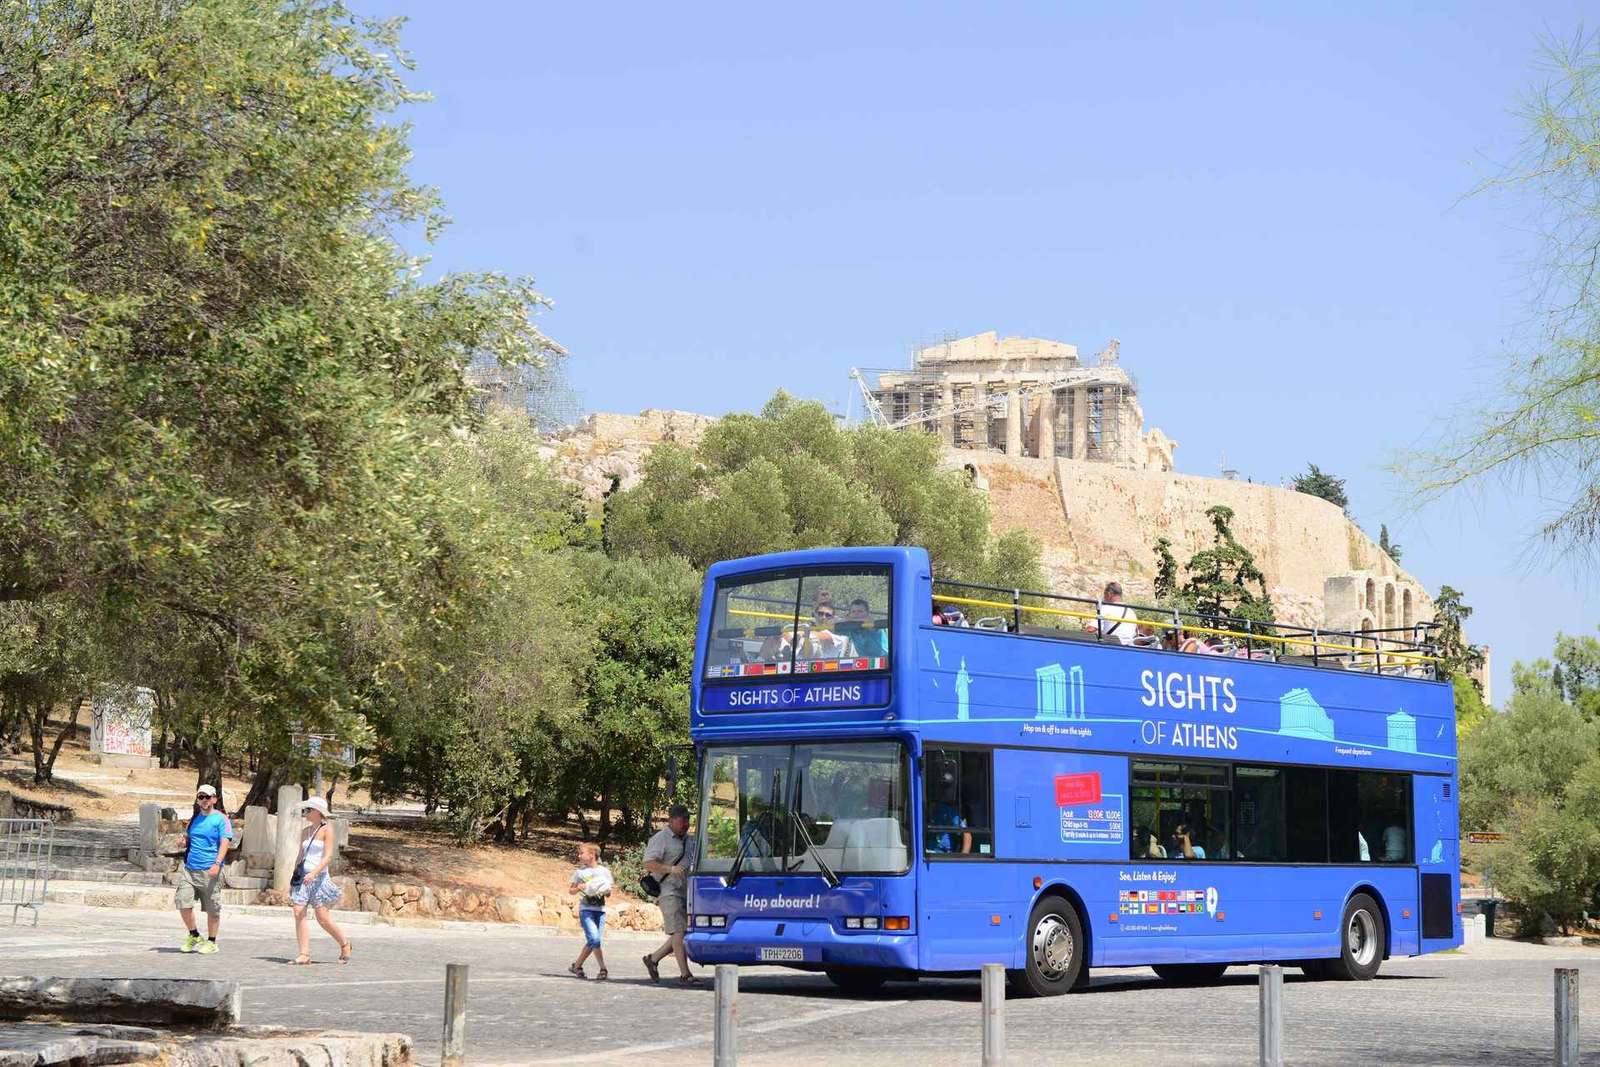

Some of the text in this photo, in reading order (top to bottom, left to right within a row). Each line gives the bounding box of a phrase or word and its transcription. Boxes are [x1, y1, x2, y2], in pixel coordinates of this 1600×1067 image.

[729, 686, 861, 706] SIGHTS OF ATHENS
[1141, 669, 1237, 714] SIGHTS
[1023, 723, 1034, 734] Hop
[1141, 720, 1238, 750] OF ATHENS
[1119, 871, 1177, 884] See, Listen & Enjoy!
[744, 894, 768, 912] Hop
